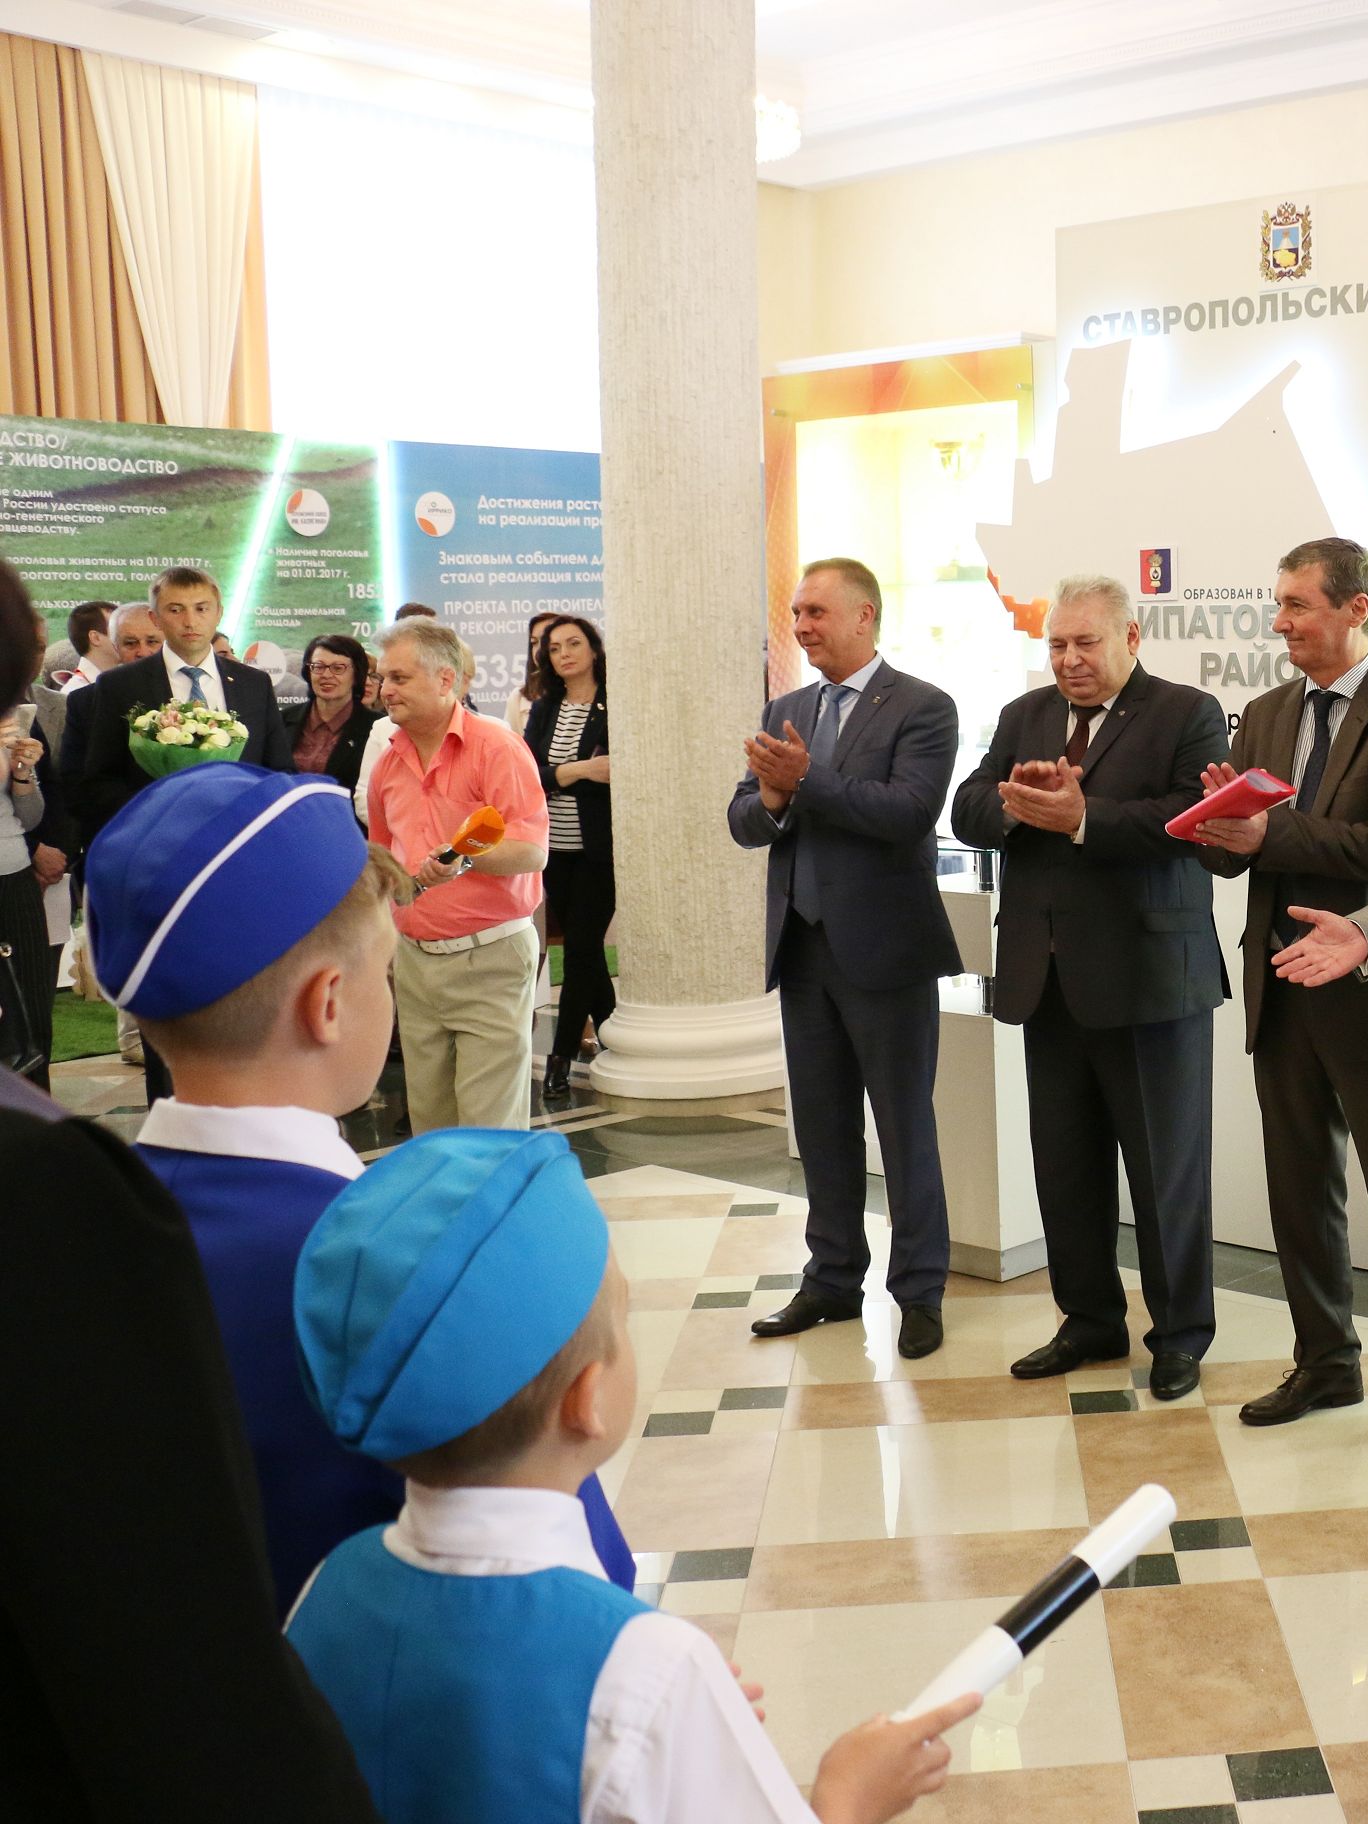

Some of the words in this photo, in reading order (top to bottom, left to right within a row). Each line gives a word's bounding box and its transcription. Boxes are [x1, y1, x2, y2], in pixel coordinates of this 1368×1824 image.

[9, 451, 178, 475] ЖИВОТНОВОДСТВО
[13, 488, 53, 499] одним
[3, 498, 48, 510] России
[51, 502, 116, 514] удостоено
[119, 505, 167, 516] статуса
[477, 495, 563, 509] Достижения
[479, 515, 496, 525] на
[500, 515, 580, 528] реализации
[276, 547, 318, 557] Наличие
[320, 549, 369, 559] поголовья
[439, 551, 512, 566] Знаковым
[516, 551, 587, 566] событием
[69, 557, 127, 567] животных
[130, 558, 144, 566] на
[146, 556, 202, 568] 01.01.2017
[204, 559, 212, 568] г.
[277, 559, 326, 569] животных
[84, 571, 127, 582] скота,
[277, 569, 290, 578] на
[292, 568, 341, 579] 01.01.2017
[440, 571, 484, 584] стала
[488, 571, 571, 585] реализация
[575, 571, 604, 583] ком
[1183, 587, 1253, 600] ОБРАЗОВАН
[1257, 587, 1264, 600] В
[255, 606, 291, 618] Общая
[293, 607, 346, 617] земельная
[444, 600, 510, 616] ПРОЕКТА
[512, 600, 533, 614] ПО
[536, 598, 604, 615] СТРОИТЕЛ
[255, 619, 302, 628] площадь
[1199, 641, 1303, 688] РАЙО
